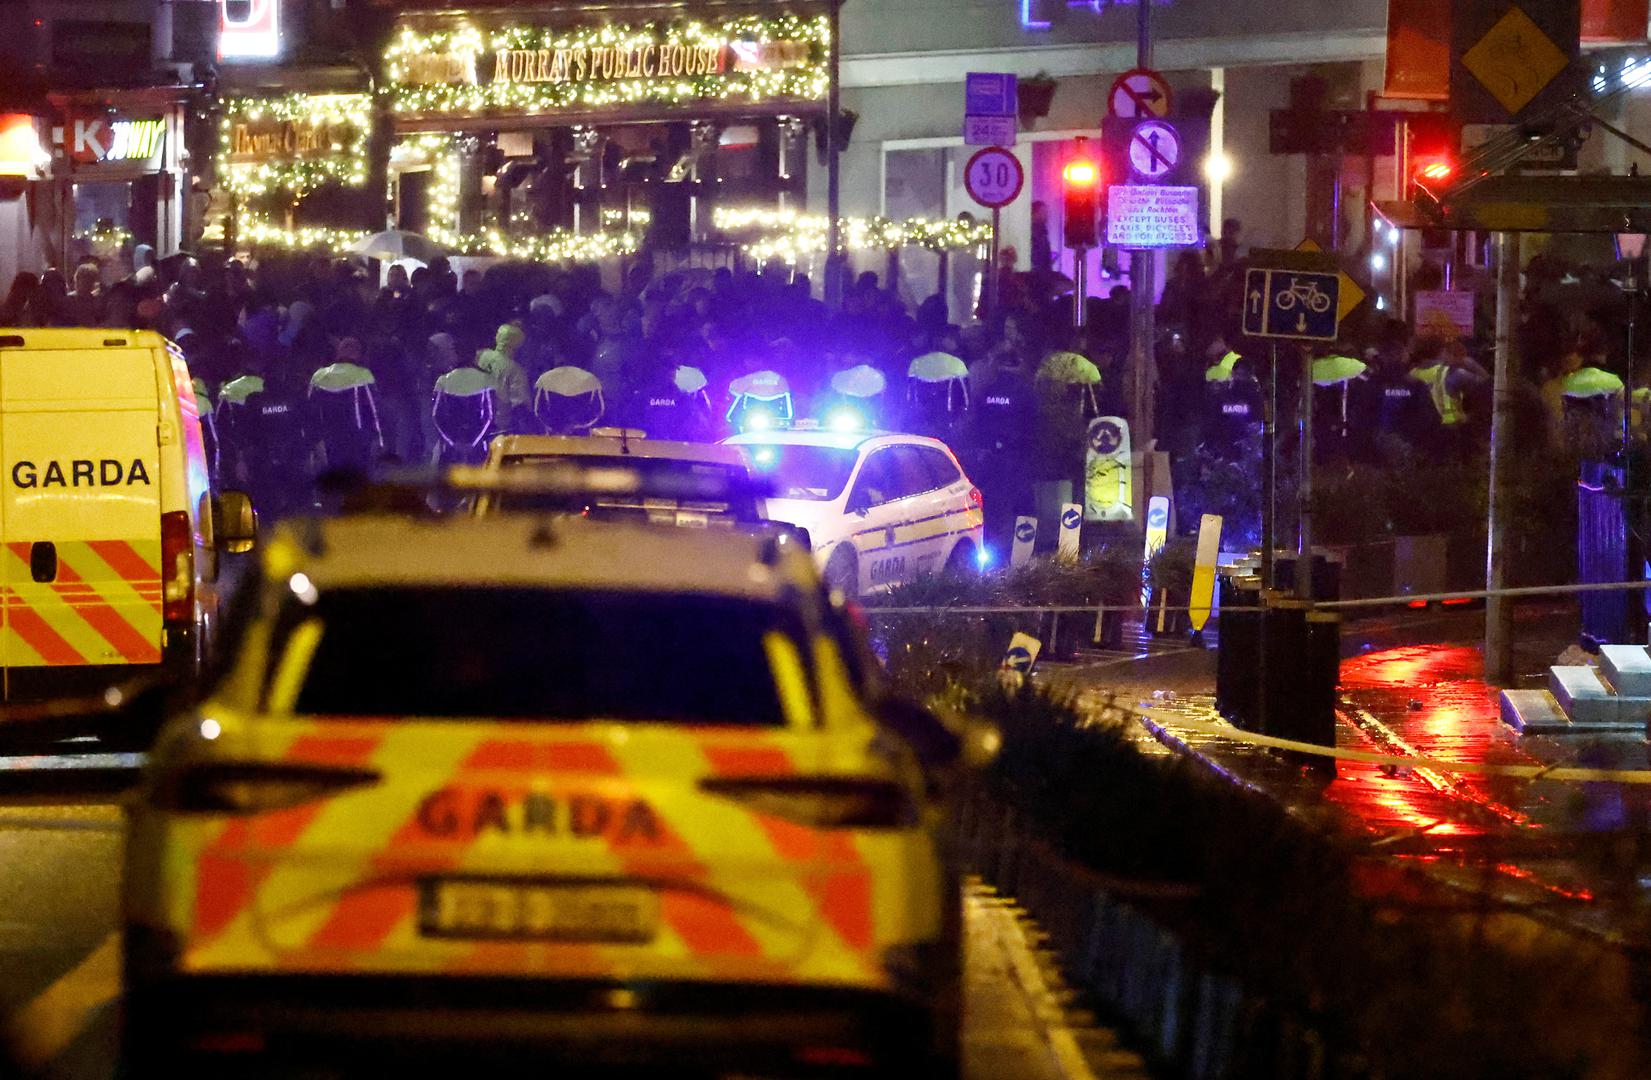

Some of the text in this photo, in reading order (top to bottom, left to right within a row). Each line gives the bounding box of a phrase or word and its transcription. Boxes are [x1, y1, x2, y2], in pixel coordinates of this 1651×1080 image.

[493, 44, 719, 83] MURRAY'S PUBLIC HOUSE
[979, 162, 1009, 188] 30
[650, 398, 676, 406] GARDA
[987, 396, 1010, 405] GARDA
[1223, 404, 1249, 414] GARDA
[12, 458, 151, 489] GARDA
[870, 556, 906, 580] GARDA
[415, 788, 664, 838] GARDA
